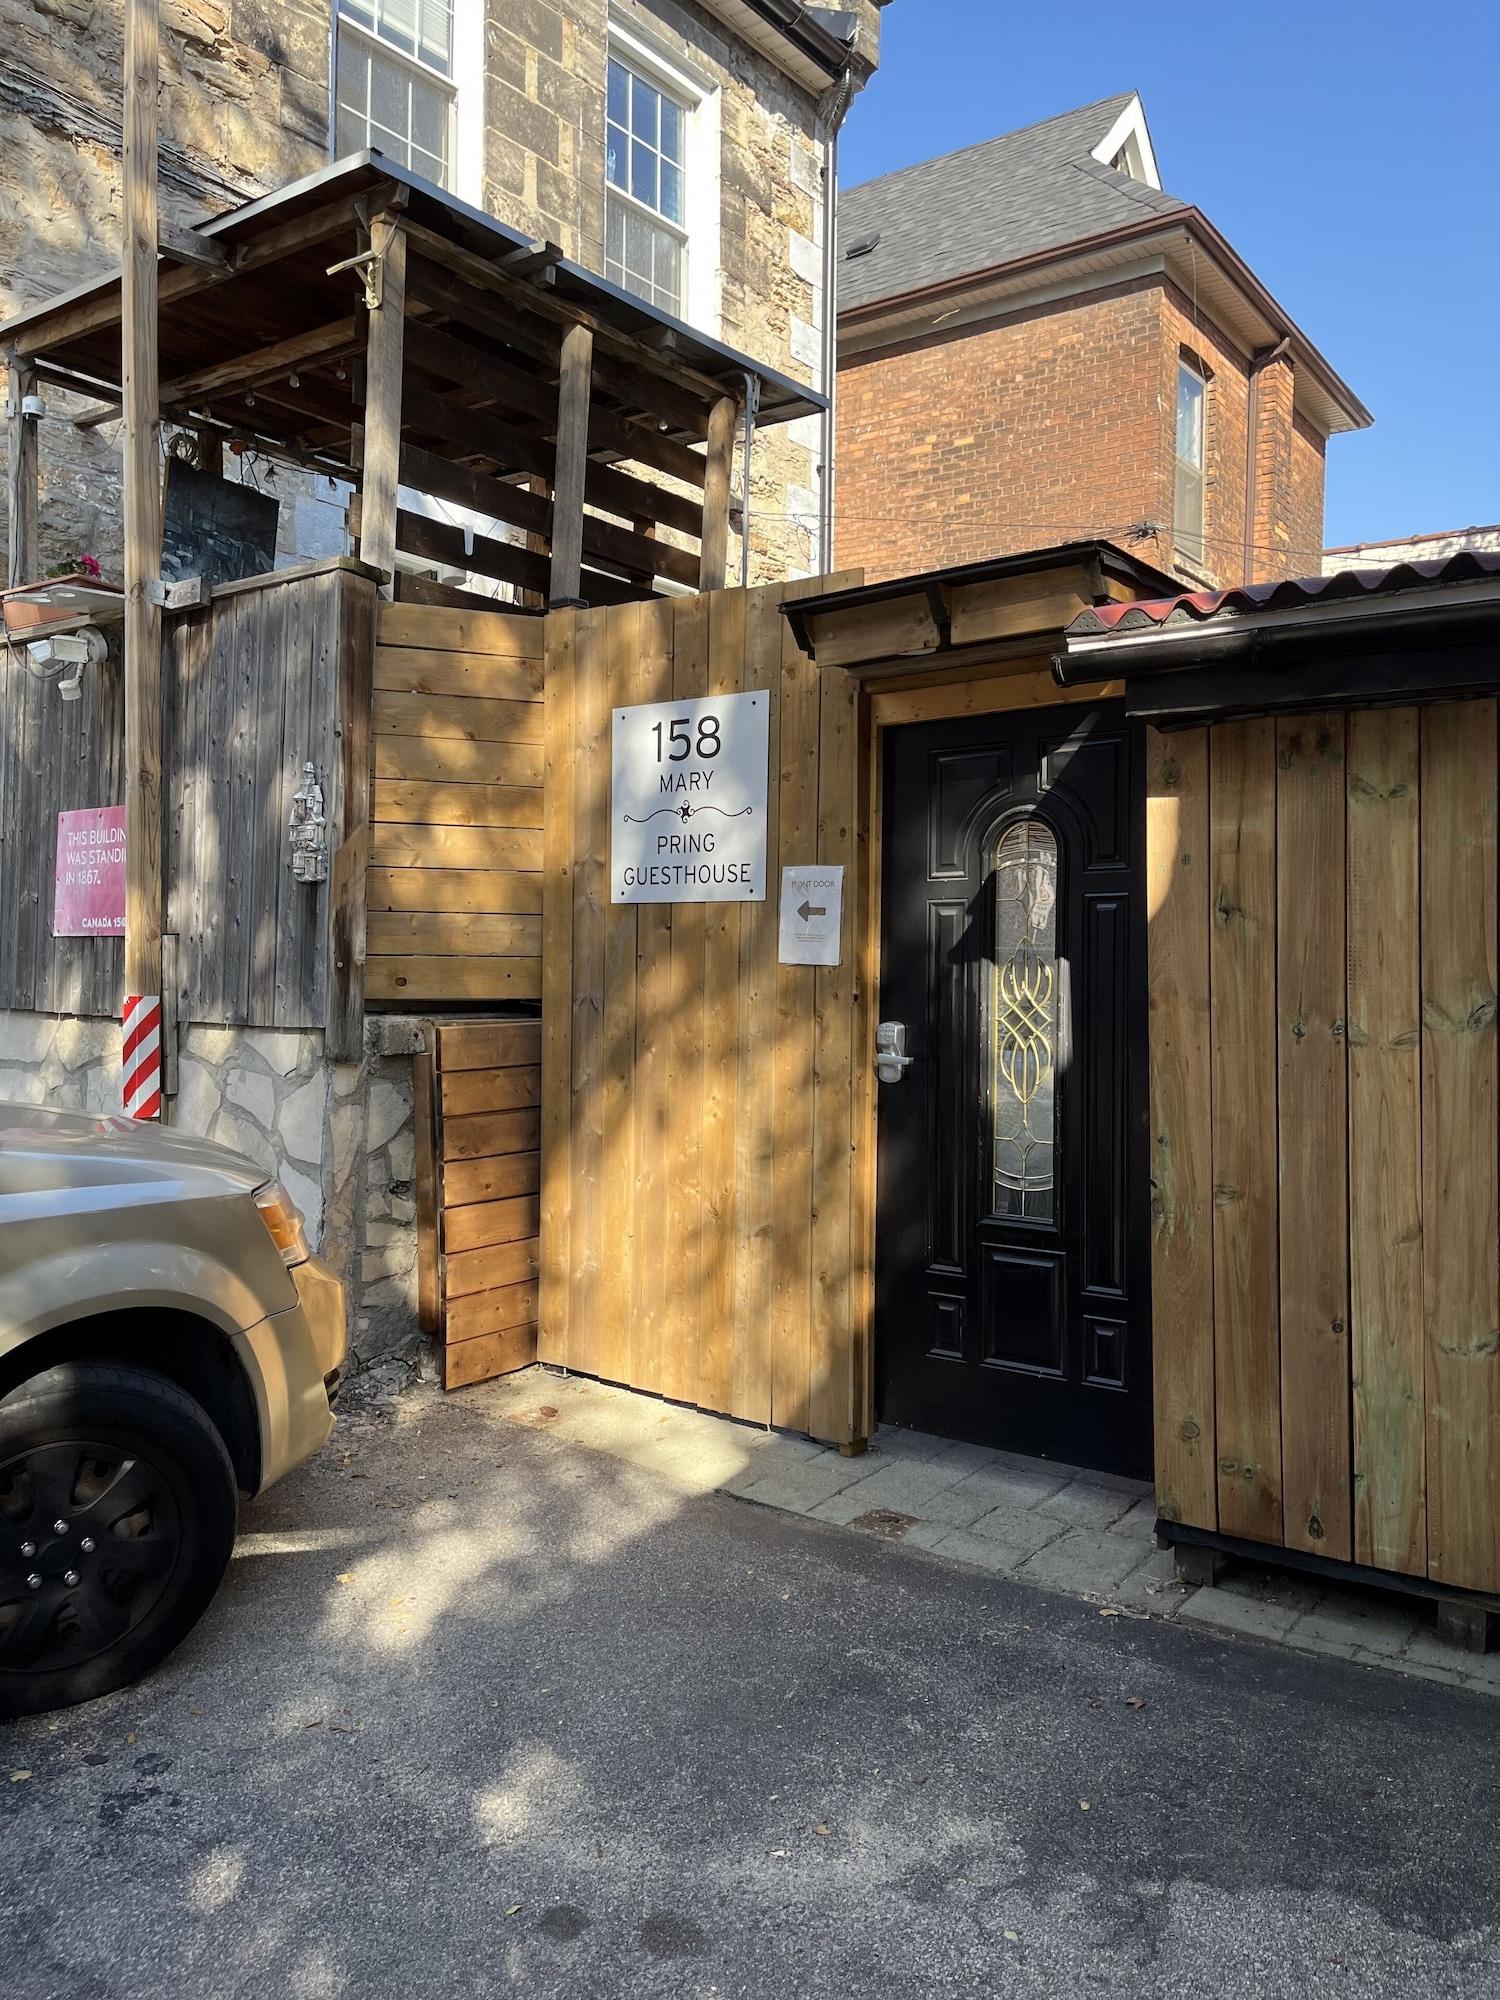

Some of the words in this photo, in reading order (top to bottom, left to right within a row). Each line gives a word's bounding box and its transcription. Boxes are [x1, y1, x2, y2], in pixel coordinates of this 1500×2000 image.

[652, 715, 721, 762] 158
[660, 770, 714, 793] MARY
[67, 831, 87, 846] THIS
[657, 833, 715, 855] PRING
[66, 851, 87, 865] WAS
[65, 872, 75, 885] IN
[77, 870, 101, 885] 1867.
[623, 863, 751, 886] GUESTHOUSE
[813, 880, 836, 888] DOOR
[82, 917, 112, 928] CANADA
